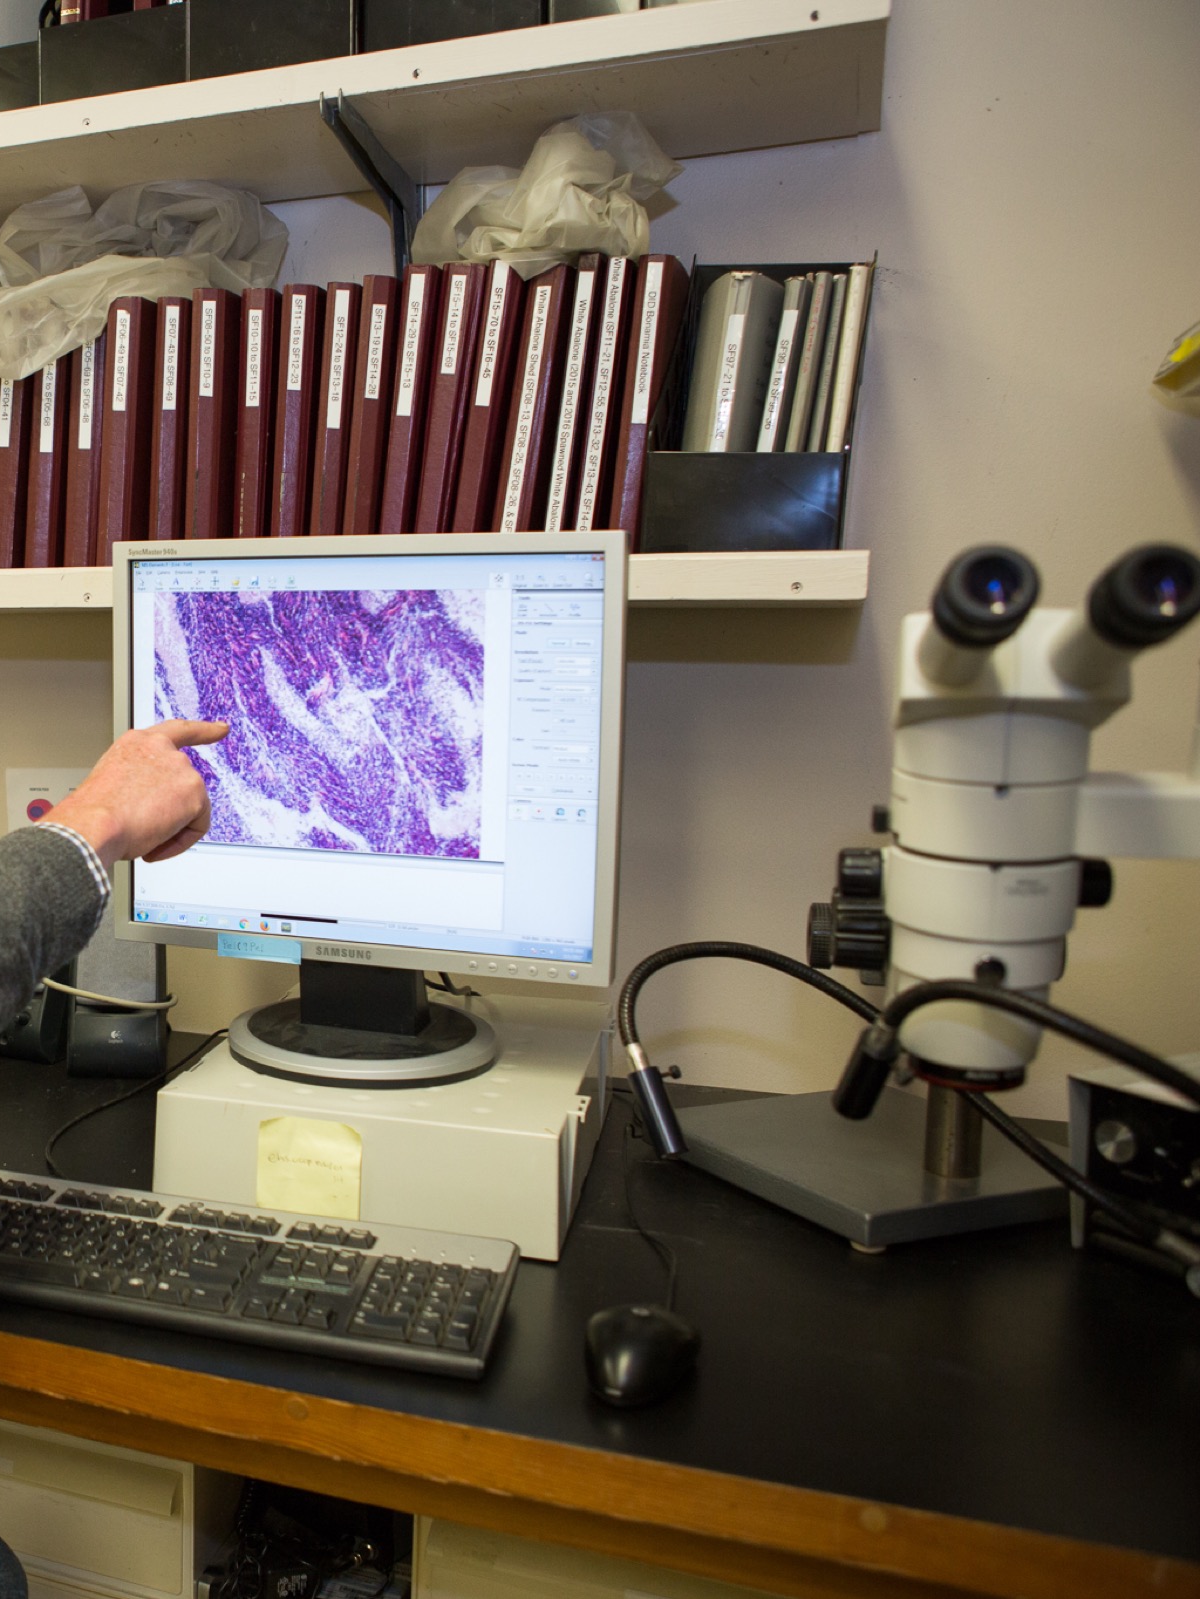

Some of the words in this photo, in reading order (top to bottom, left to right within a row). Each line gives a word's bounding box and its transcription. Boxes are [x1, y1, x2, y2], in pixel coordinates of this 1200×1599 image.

[611, 258, 622, 282] White
[451, 281, 462, 317] SF15-14
[490, 287, 503, 327] SF15-70
[537, 289, 548, 314] White
[577, 299, 587, 324] White
[606, 285, 619, 319] Abalone
[335, 316, 345, 353] SF12-24
[373, 308, 383, 345] SF13-19
[408, 301, 419, 339] SF14-29
[532, 316, 545, 351] Abalone
[642, 311, 654, 350] Bonamia
[444, 330, 457, 368] SF15-69
[482, 339, 496, 379] SF16-45
[571, 327, 584, 362] Abalone
[775, 340, 790, 374] SF99-1
[291, 348, 300, 384] SF12-23
[368, 357, 378, 394] SF14-28
[403, 351, 414, 388] SF15-13
[528, 354, 540, 376] Shed
[567, 363, 580, 388] (2015
[638, 352, 650, 394] Notebook
[723, 344, 737, 384] SF97-21
[116, 366, 125, 402] SF07-42
[249, 364, 258, 401] SF11-15
[331, 365, 342, 402] SF13-18
[566, 389, 575, 406] and
[562, 408, 573, 429] 2016
[555, 431, 570, 471] Spawned
[553, 473, 565, 497] White
[316, 946, 372, 960] SAMSUNG
